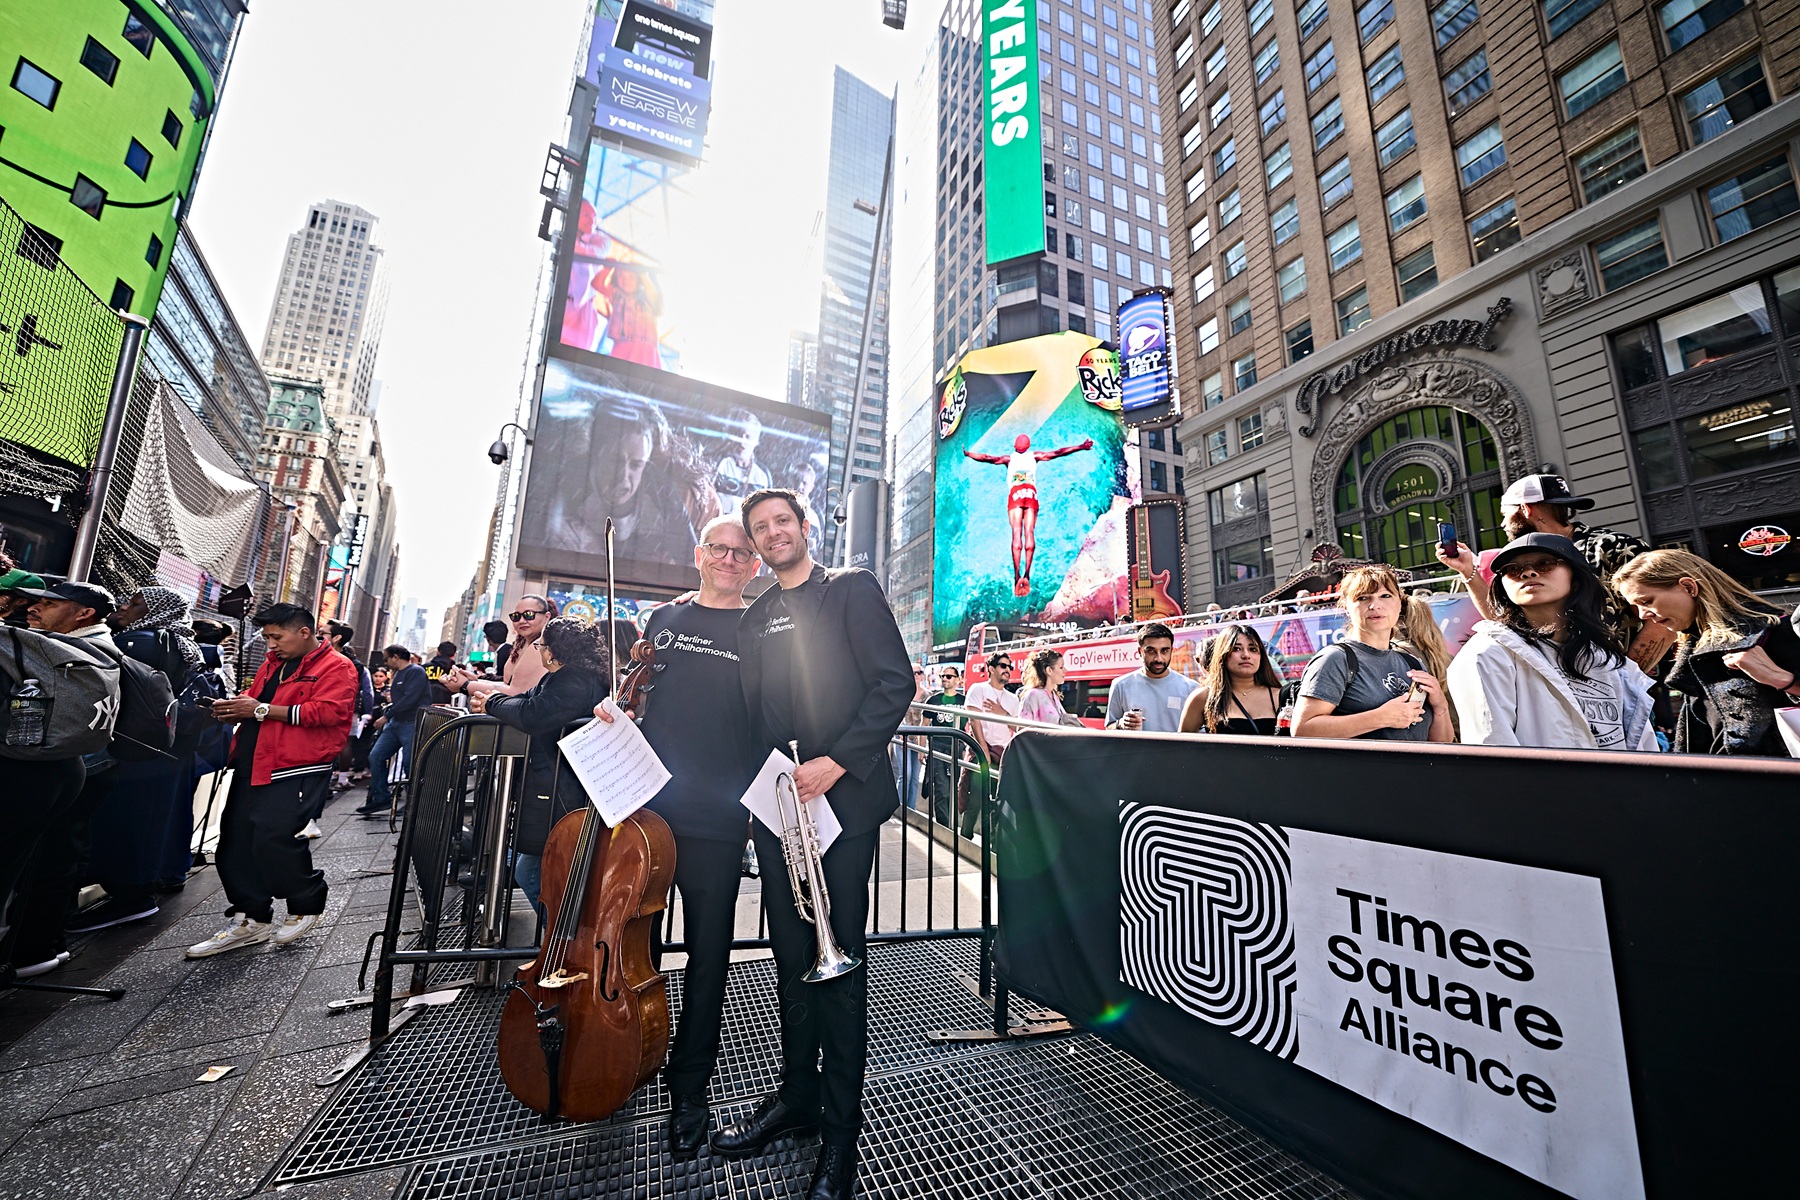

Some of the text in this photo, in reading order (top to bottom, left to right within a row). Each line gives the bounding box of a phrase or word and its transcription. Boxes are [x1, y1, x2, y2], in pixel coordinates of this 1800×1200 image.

[634, 14, 700, 45] one times square
[623, 58, 692, 89] Celebrate
[990, 0, 1029, 146] YEARS
[611, 92, 696, 129] YEAR'S EVE
[612, 76, 698, 116] NEW
[608, 115, 693, 148] year-round
[1126, 350, 1162, 369] TACO
[1129, 361, 1163, 379] BELL
[1296, 297, 1511, 437] Paramount
[1390, 488, 1434, 506] BROADWAY
[1396, 475, 1424, 491] 1501
[348, 515, 368, 565] Foot Locker
[771, 616, 790, 626] Berliner
[677, 633, 714, 646] Berliner
[1336, 887, 1535, 982] Times
[1327, 935, 1564, 1051] Square
[1339, 997, 1557, 1114] Alliance
